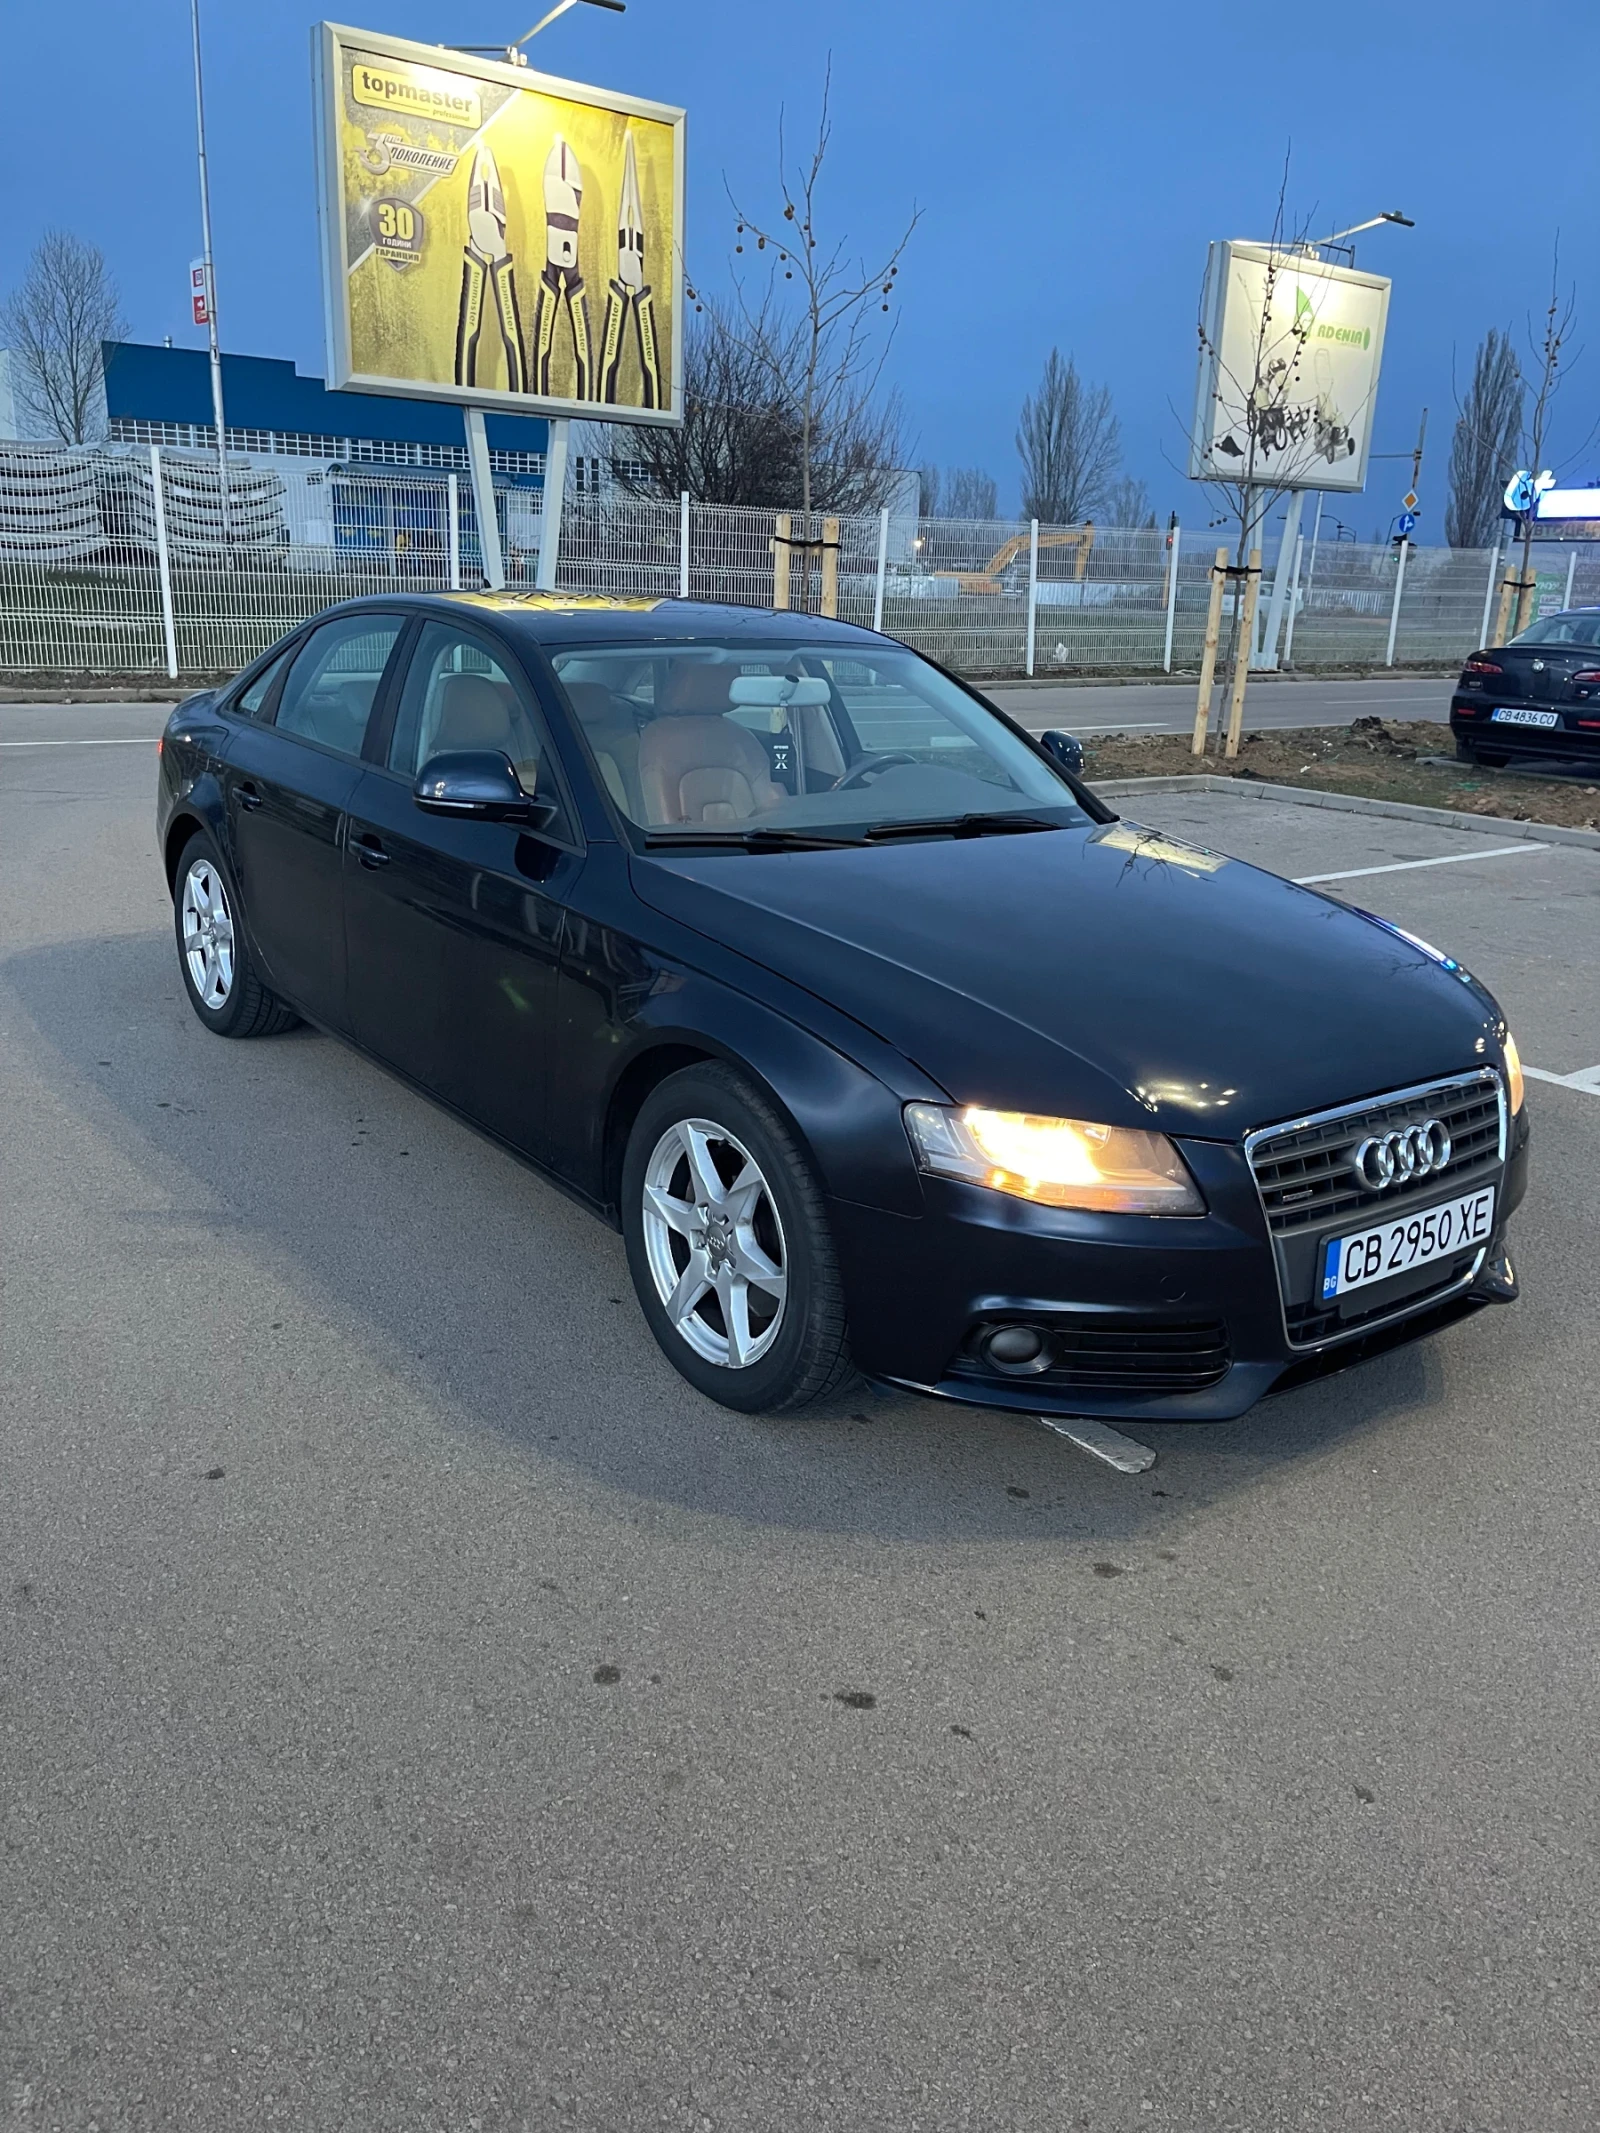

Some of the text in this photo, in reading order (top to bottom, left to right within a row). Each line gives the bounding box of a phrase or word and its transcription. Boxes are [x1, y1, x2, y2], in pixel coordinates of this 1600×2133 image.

[362, 71, 473, 112] topmaster
[391, 147, 454, 170] ПОКОЛЕНИЕ
[378, 203, 414, 240] 30
[382, 237, 412, 249] ГОДИНИ
[375, 247, 420, 262] ГАРАНЦИЯ
[469, 271, 480, 327] topmaster
[500, 275, 514, 332] topmaster
[541, 297, 553, 347] topmaster
[573, 301, 586, 352] topmaster
[607, 302, 620, 356] topmaster
[641, 307, 653, 362] topmaster
[1497, 710, 1555, 726] CB 4836 CO
[1344, 1194, 1490, 1284] CB 2950 XE
[1323, 1275, 1337, 1291] BG
